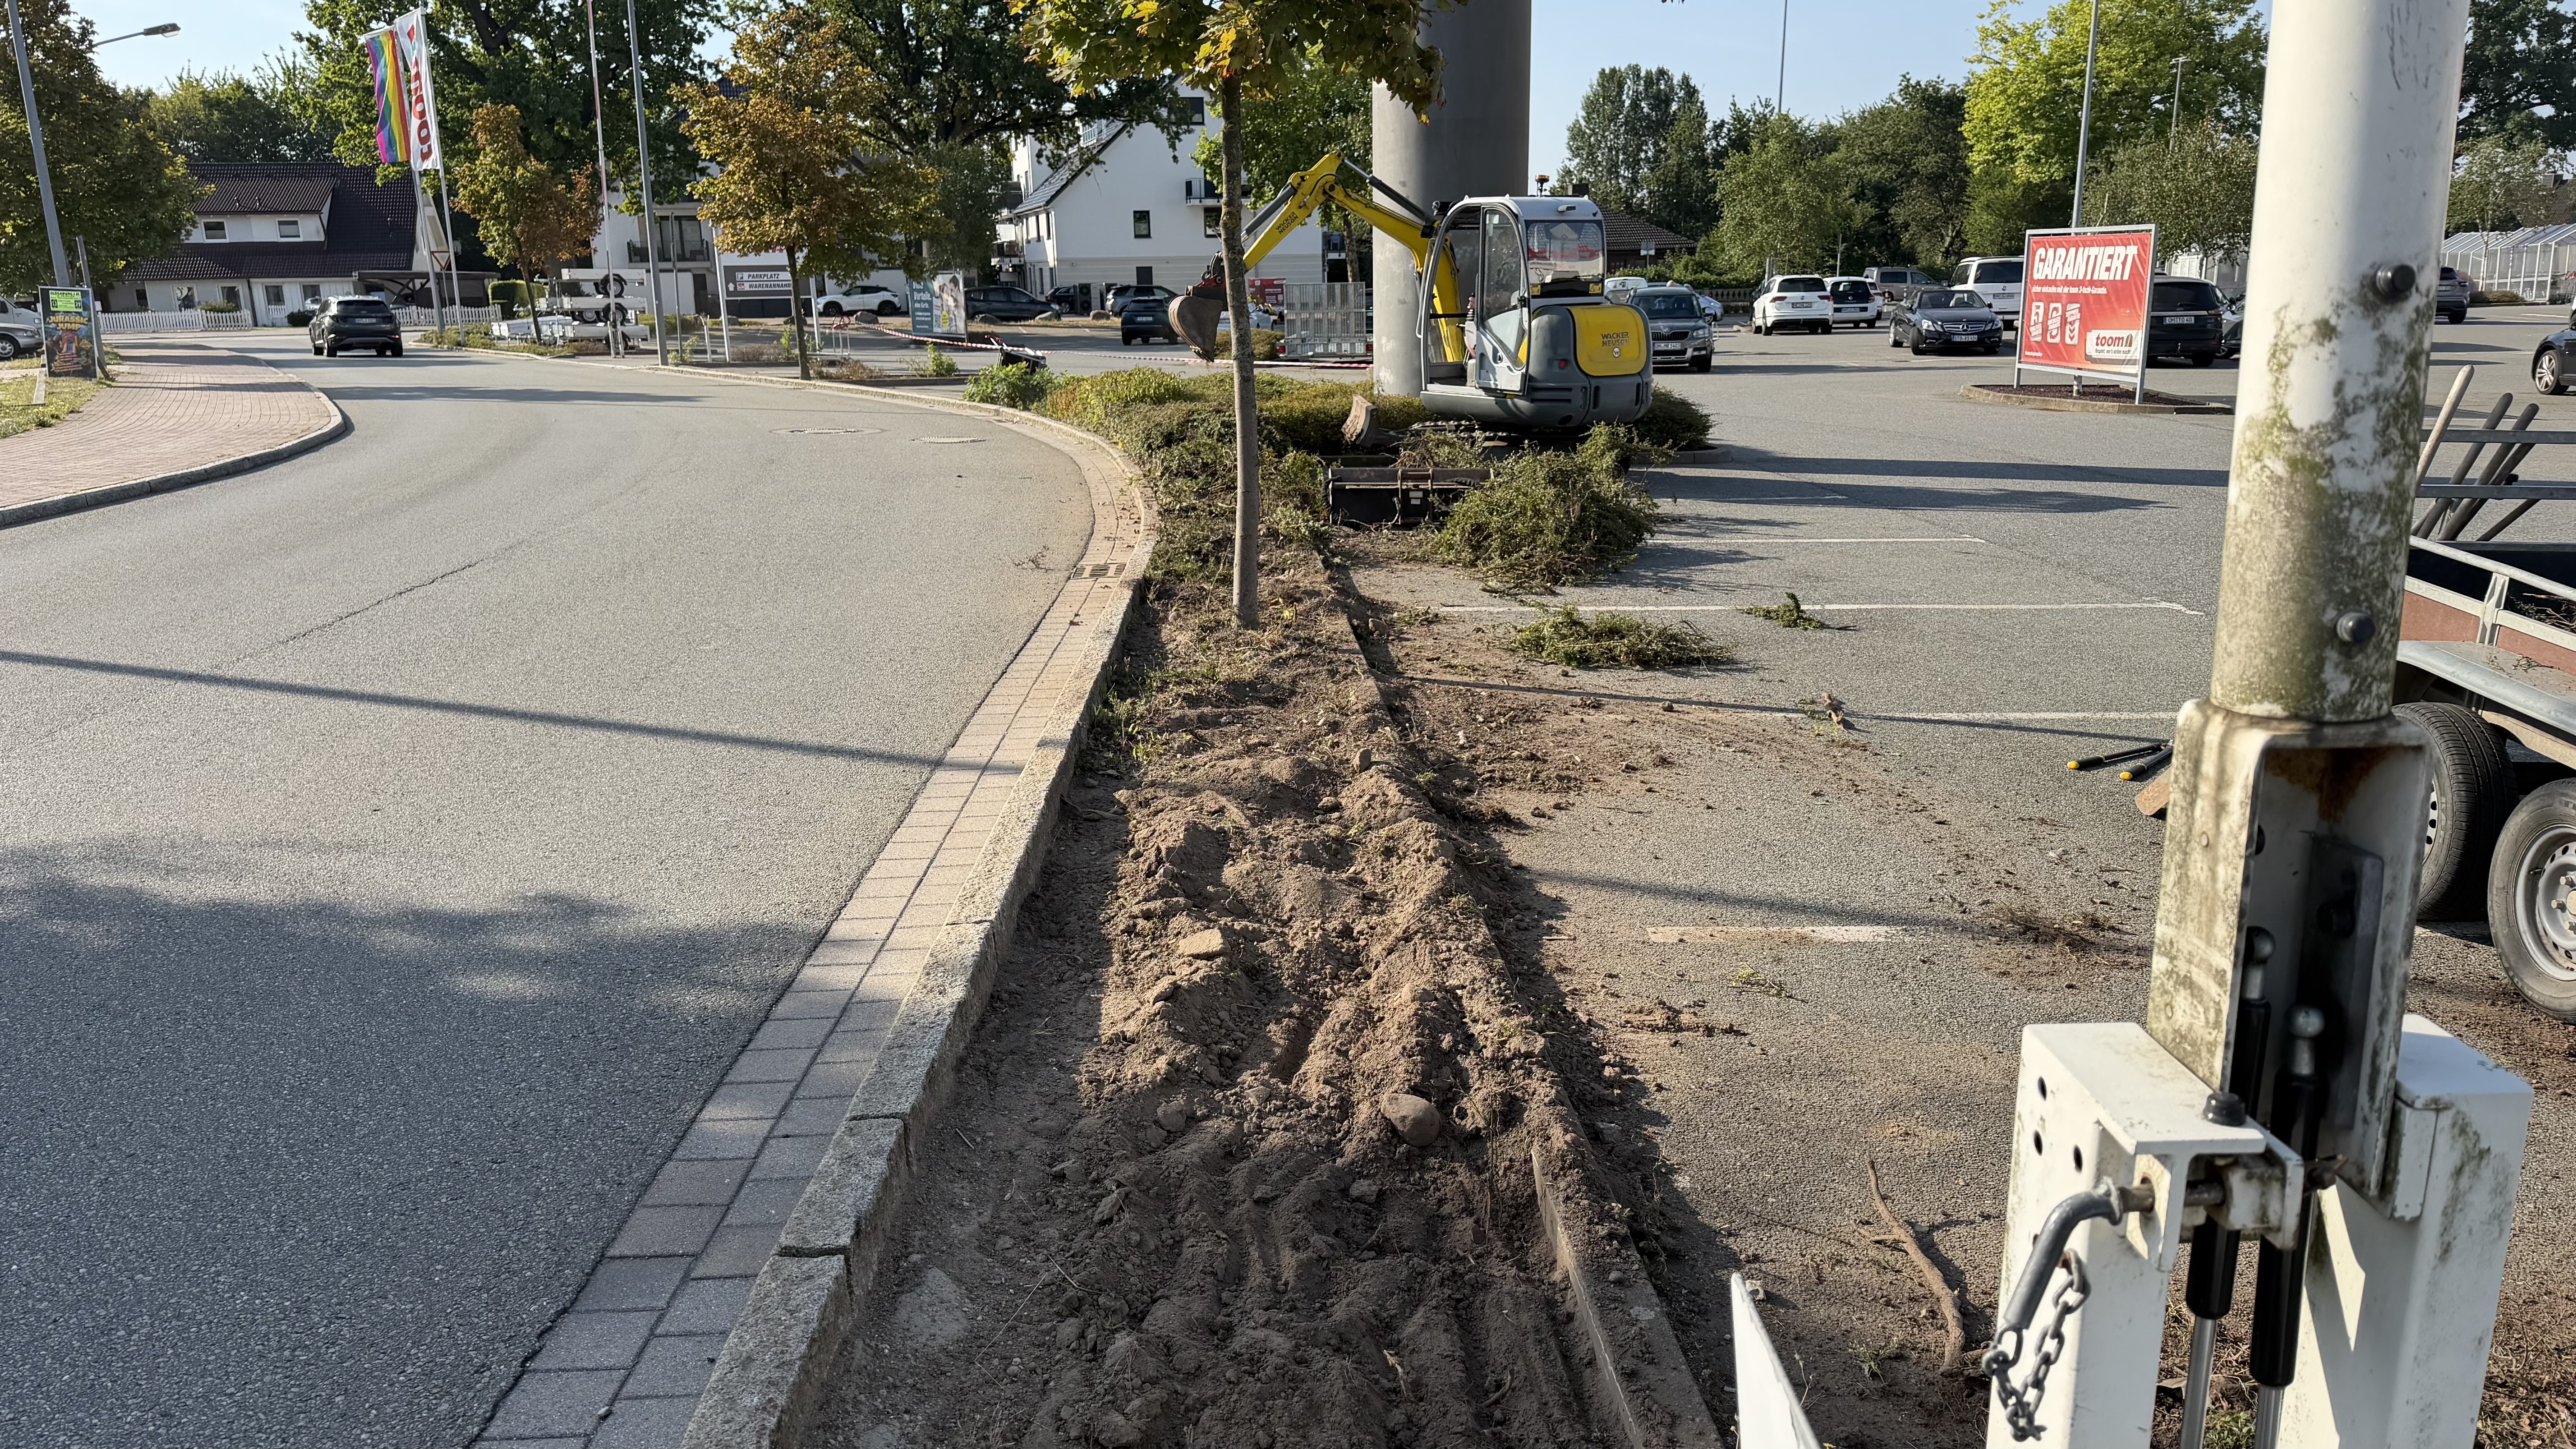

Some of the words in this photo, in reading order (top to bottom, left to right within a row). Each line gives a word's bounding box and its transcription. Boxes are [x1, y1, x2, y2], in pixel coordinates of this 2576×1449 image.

[1275, 211, 1295, 230] WACKER
[1279, 214, 1299, 235] NEUSON
[2033, 245, 2138, 280] GARANTIERT
[48, 316, 88, 324] JURASSIC
[1602, 339, 1629, 347] NEUSON
[2096, 333, 2125, 347] toom
